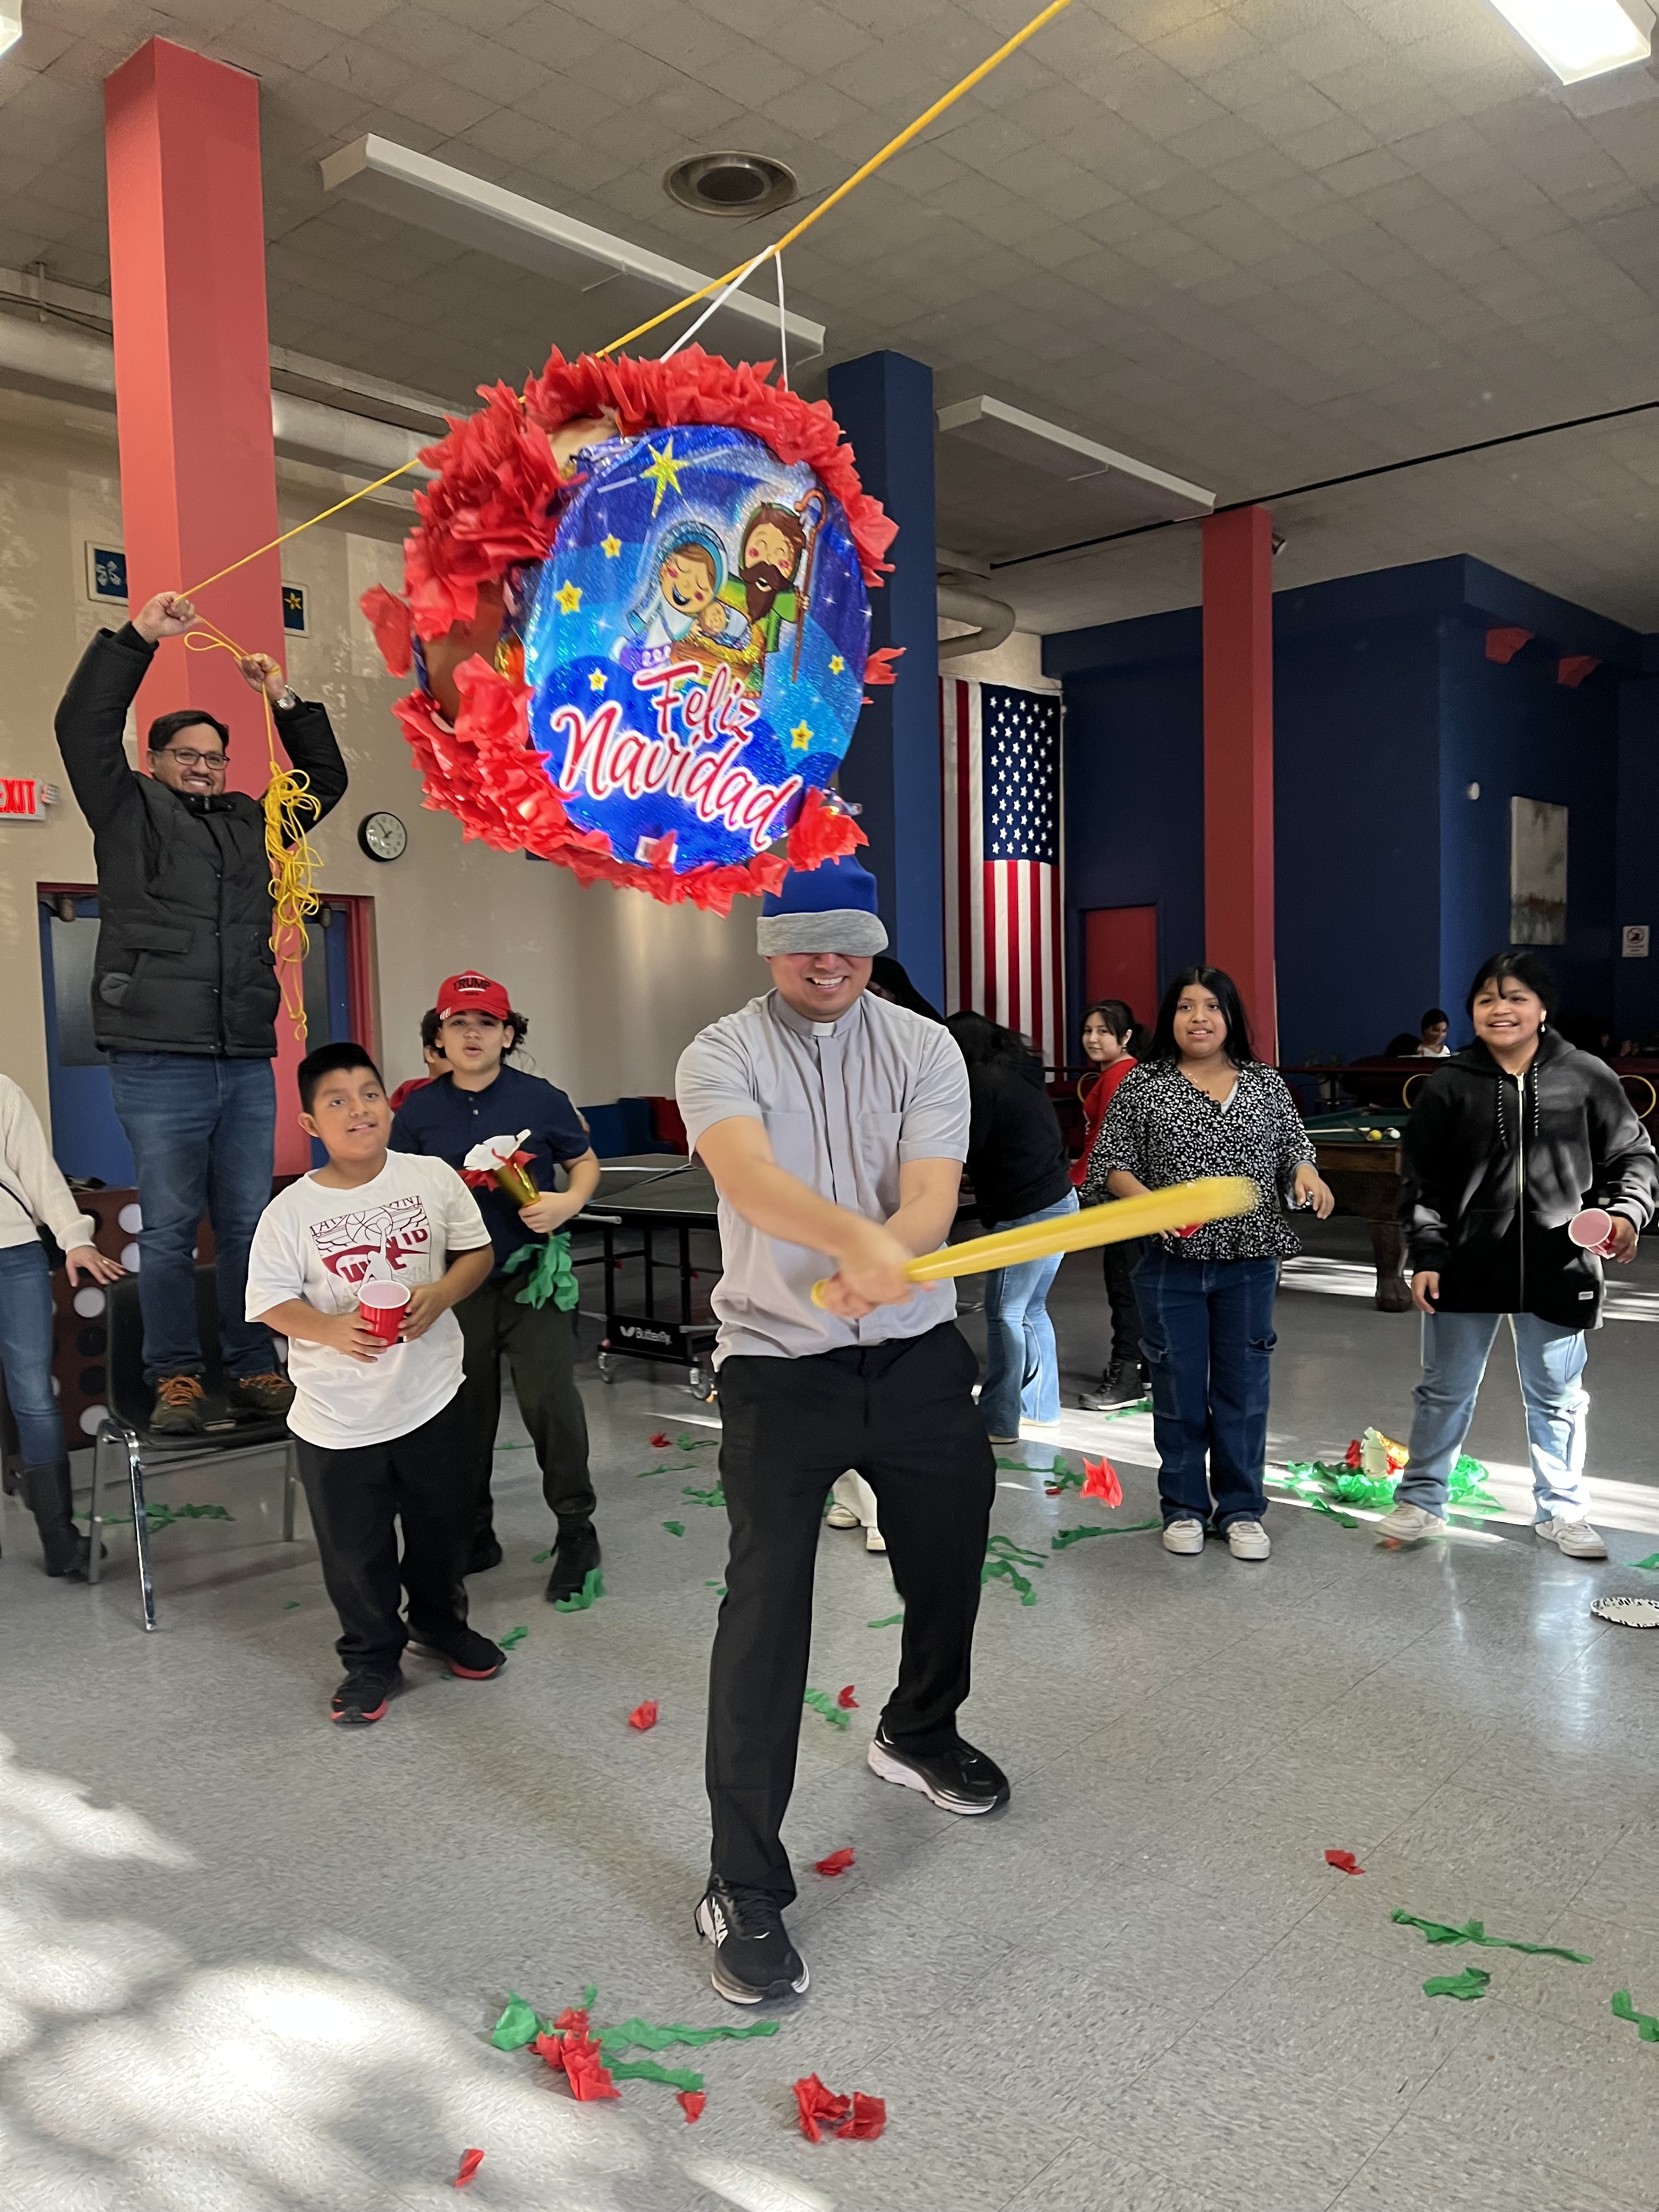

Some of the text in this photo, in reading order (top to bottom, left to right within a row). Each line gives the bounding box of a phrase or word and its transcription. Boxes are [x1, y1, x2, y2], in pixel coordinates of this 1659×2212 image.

[634, 662, 760, 742] Feliz
[551, 701, 803, 851] Navidad
[453, 977, 491, 990] TRUMP
